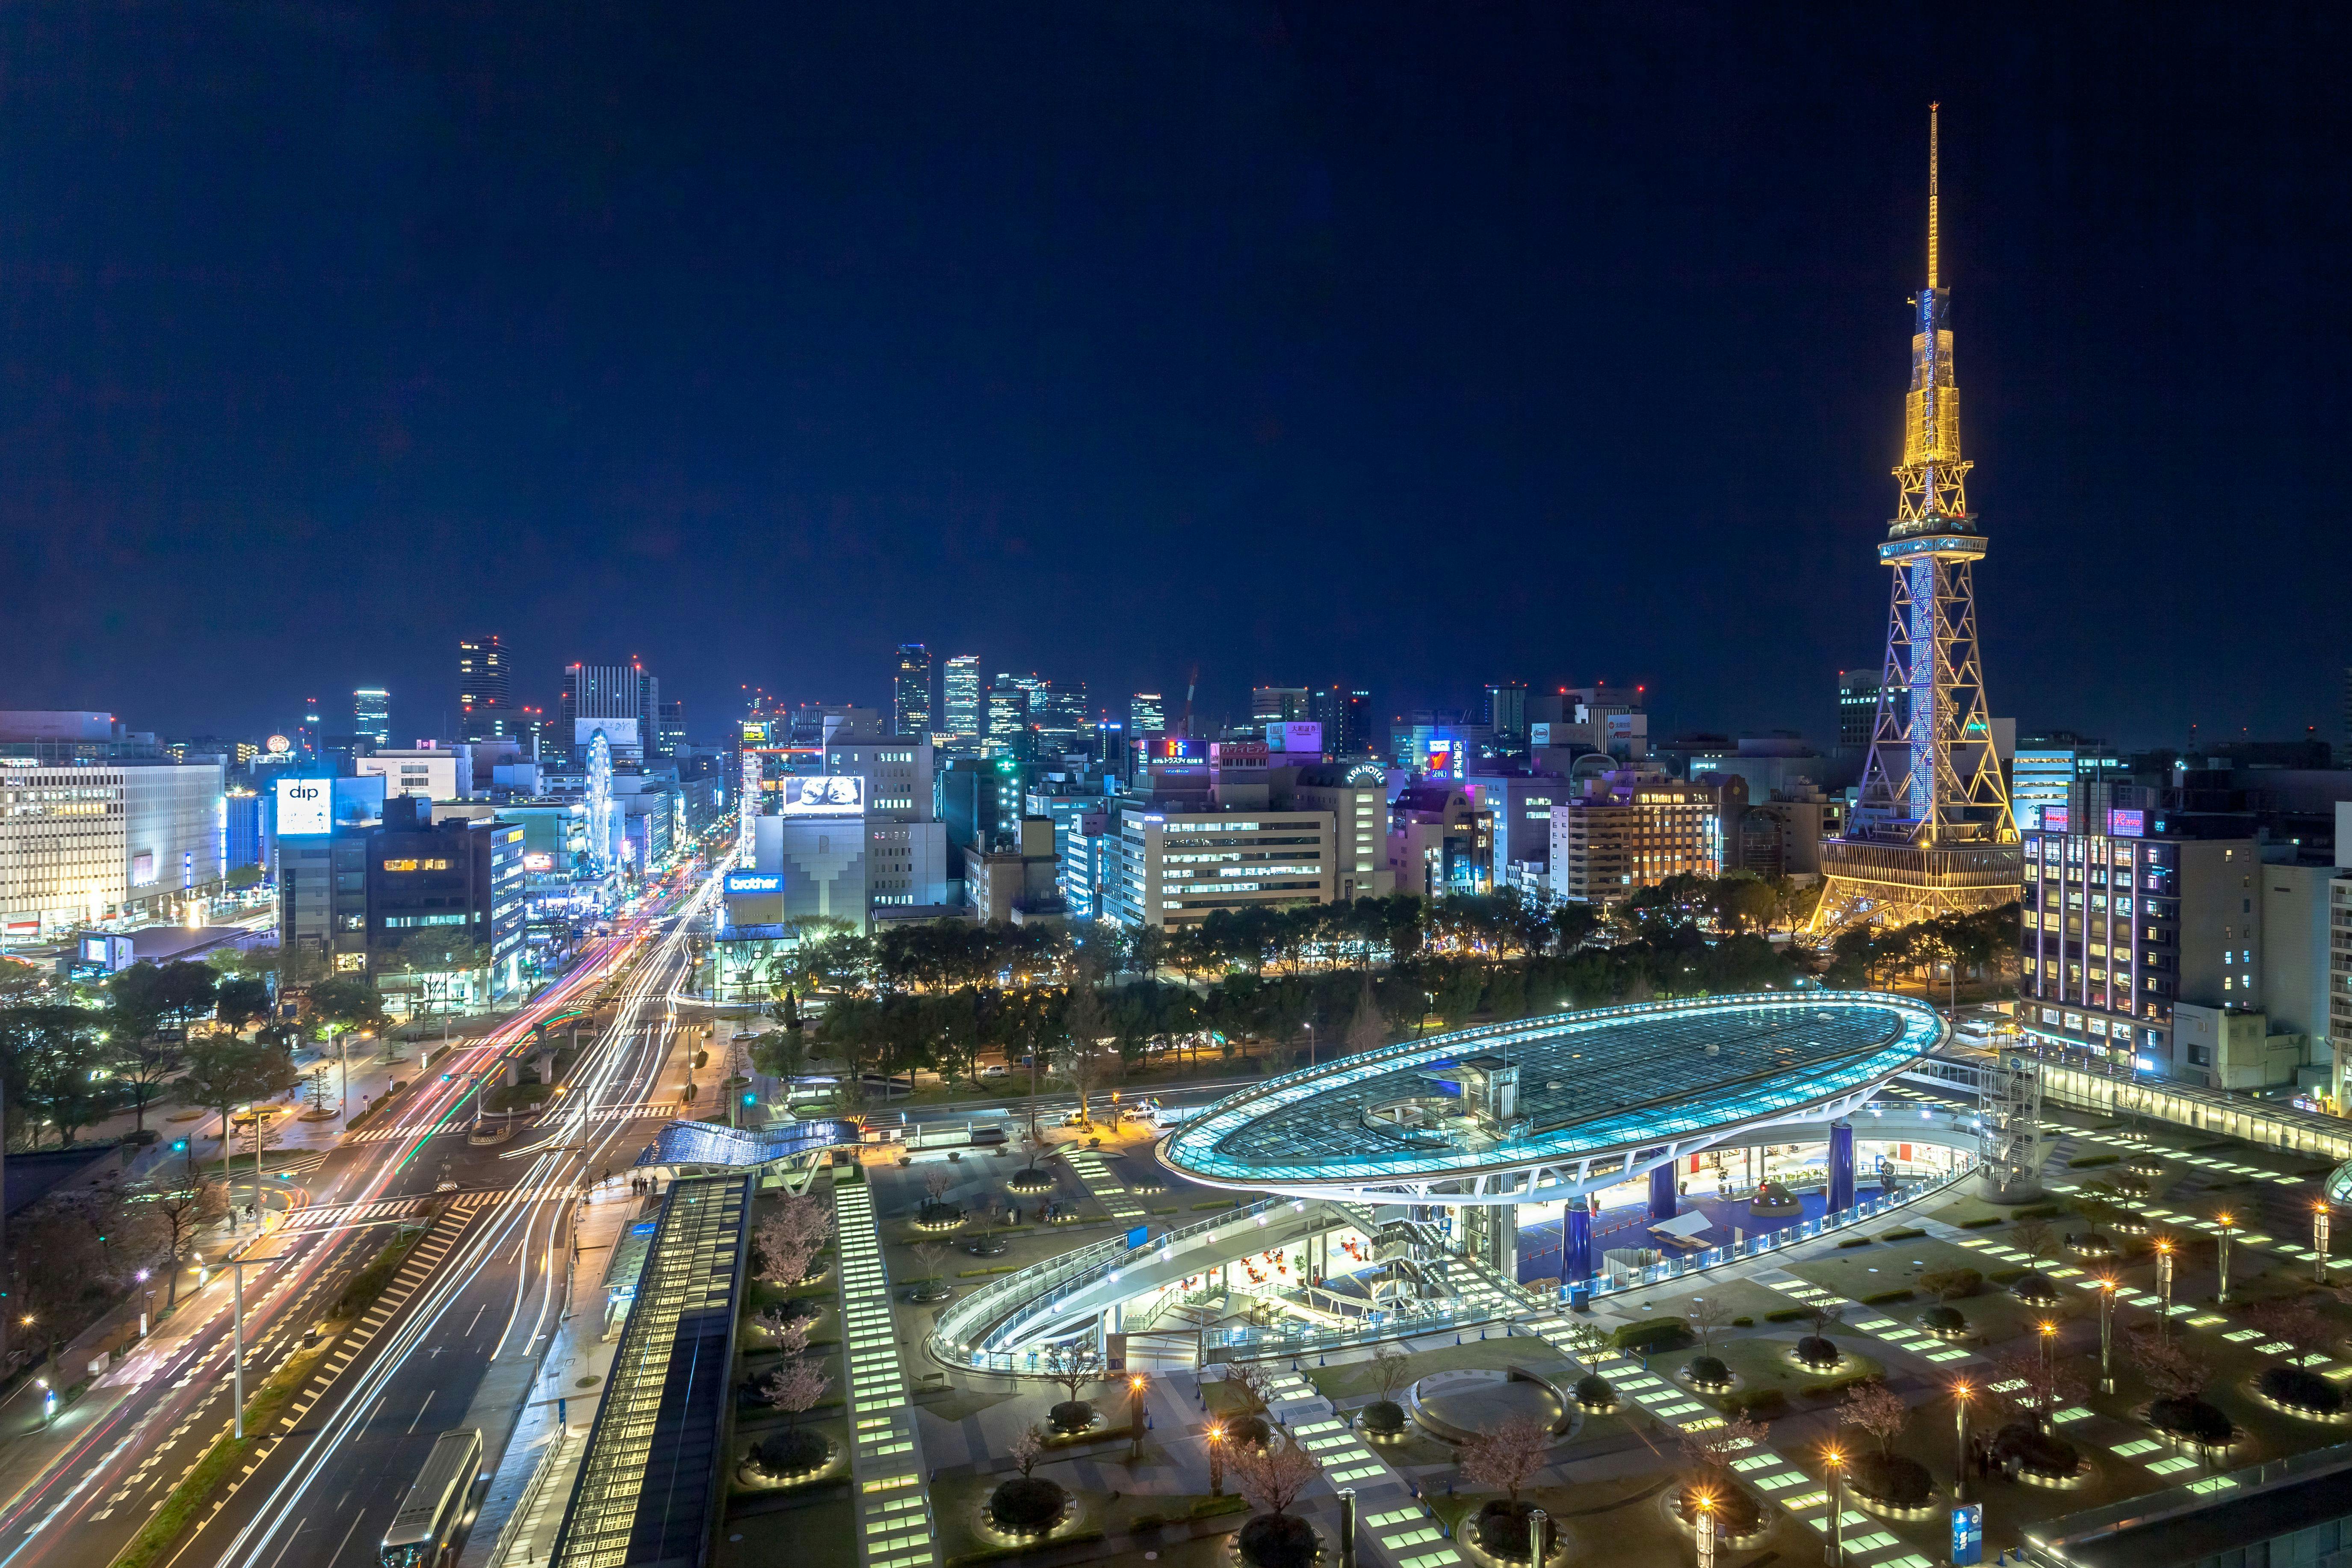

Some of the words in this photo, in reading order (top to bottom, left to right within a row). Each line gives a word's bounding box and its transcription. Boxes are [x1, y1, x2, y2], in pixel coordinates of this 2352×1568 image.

[1347, 767, 1362, 783] APA
[1362, 765, 1385, 783] HOTEL
[290, 785, 318, 801] dip
[730, 877, 778, 890] brother
